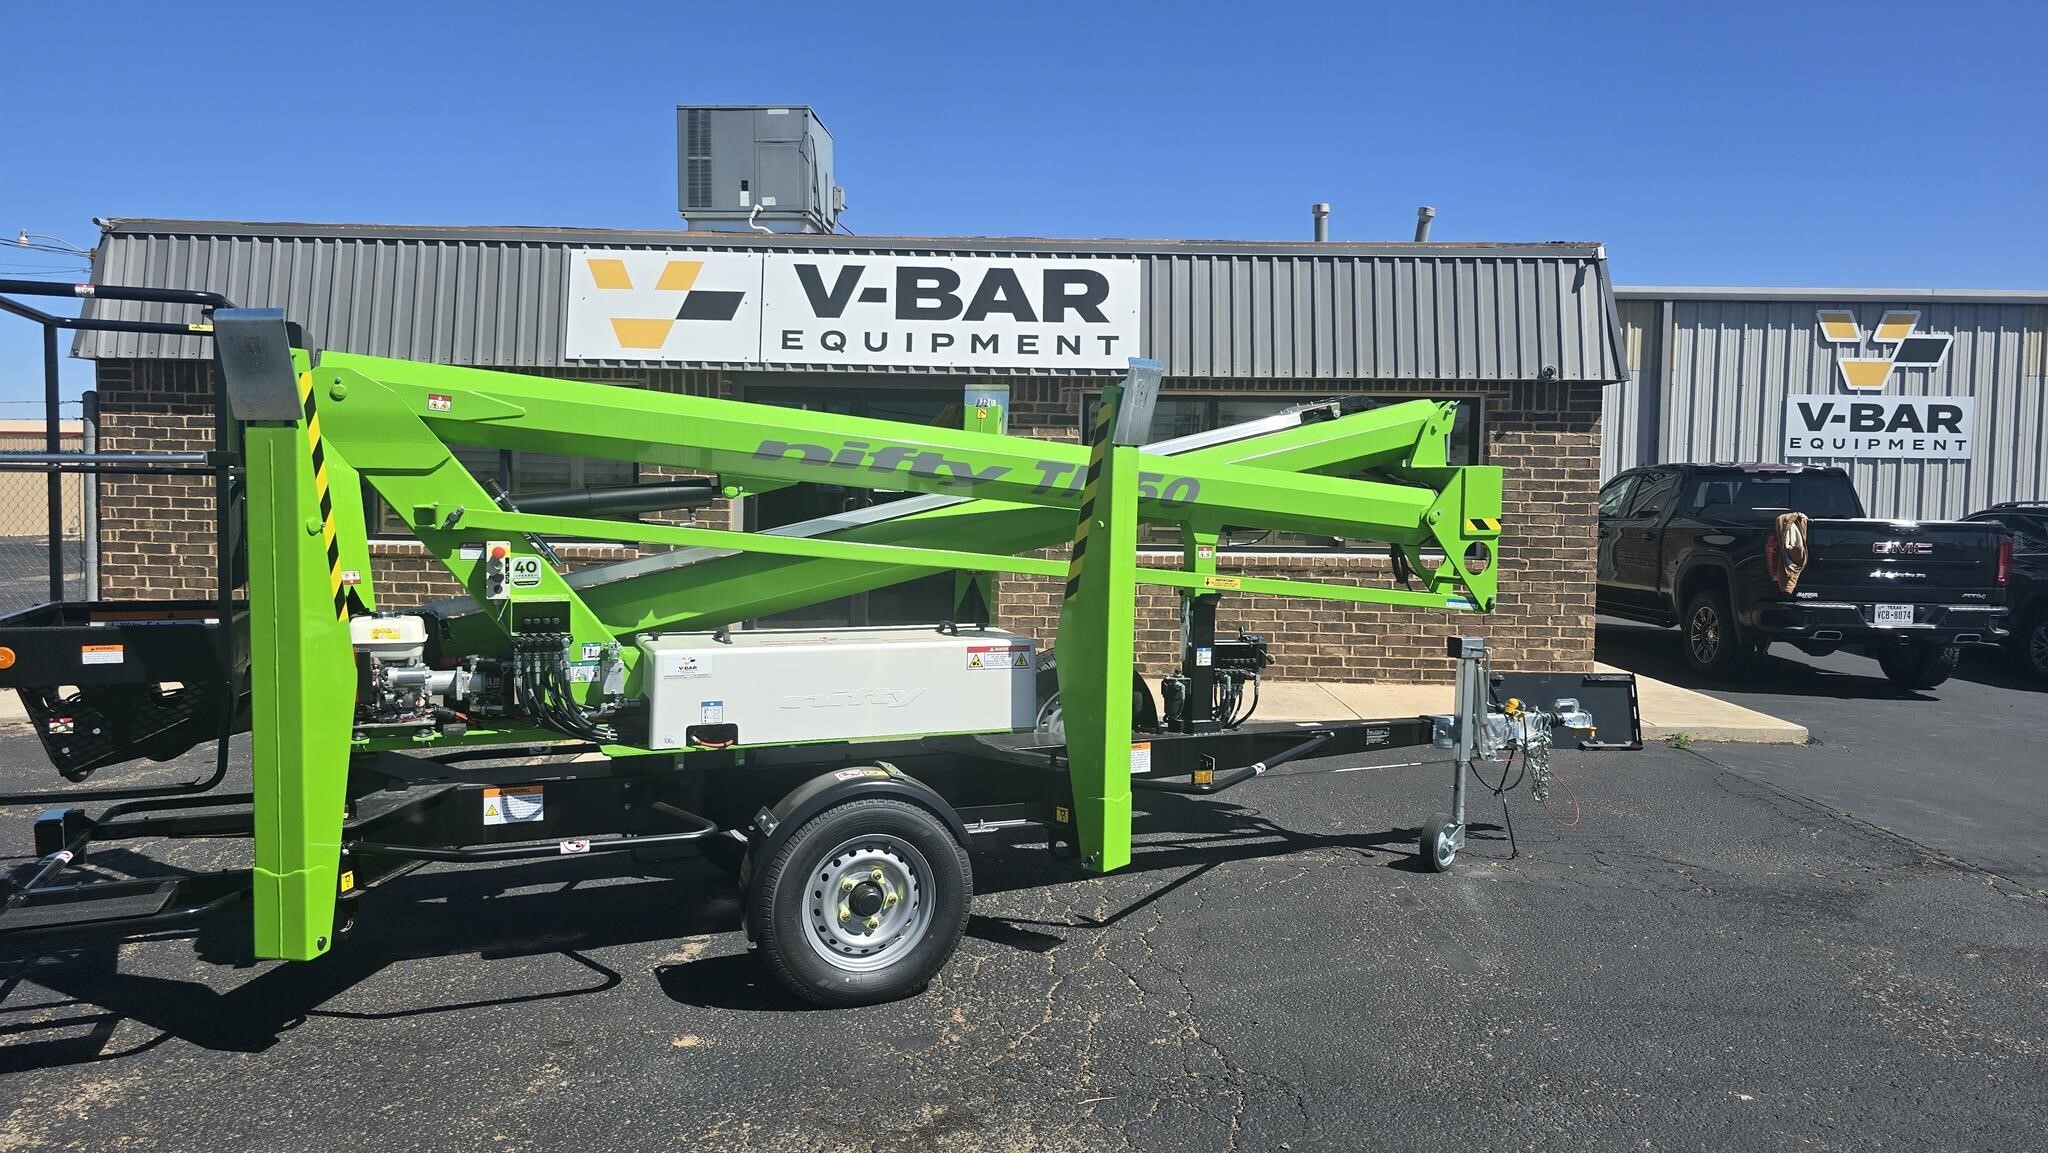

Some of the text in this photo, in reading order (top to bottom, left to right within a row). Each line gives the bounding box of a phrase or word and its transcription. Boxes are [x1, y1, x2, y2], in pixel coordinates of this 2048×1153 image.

[794, 264, 1110, 323] V-BAR
[781, 329, 1120, 356] EQUIPMENT
[1797, 402, 1963, 434] V-BAR
[1789, 437, 1967, 452] EQUIPMENT
[751, 440, 1014, 488] nifty
[1872, 542, 1933, 554] GMC
[514, 561, 537, 573] 40
